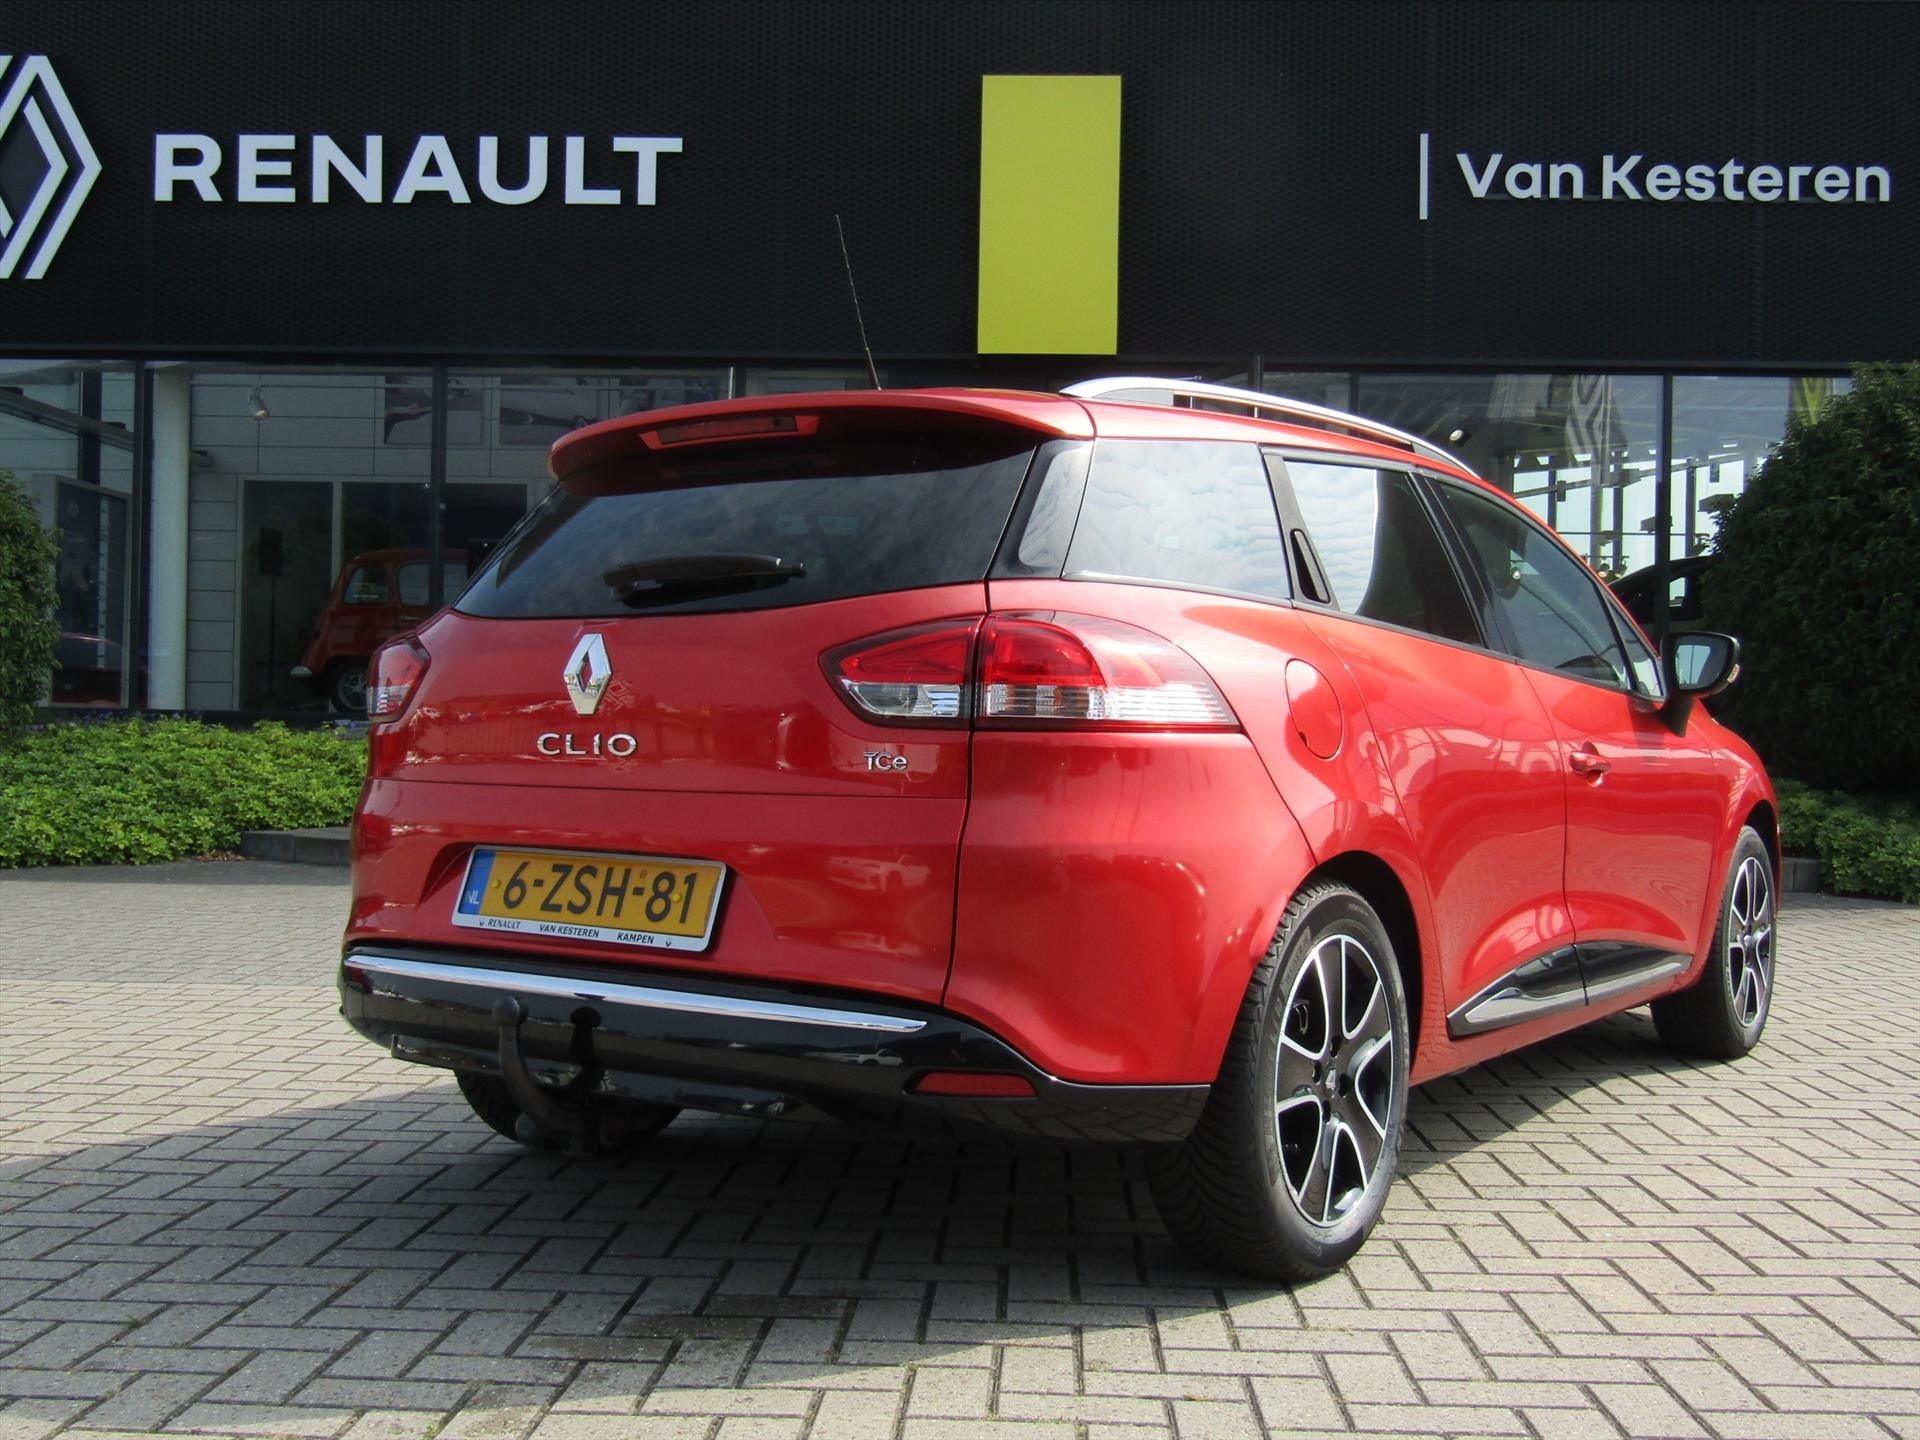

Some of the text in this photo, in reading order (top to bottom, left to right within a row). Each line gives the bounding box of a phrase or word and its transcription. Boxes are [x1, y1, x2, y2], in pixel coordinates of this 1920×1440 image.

[154, 133, 684, 206] RENAULT
[1456, 153, 1892, 203] Van Kesteren
[536, 732, 638, 756] CLIO
[863, 751, 909, 772] TCe
[502, 860, 698, 924] 6-ZSH-81
[487, 918, 655, 944] RENAULT VAN KESTEREN KAMPEN
